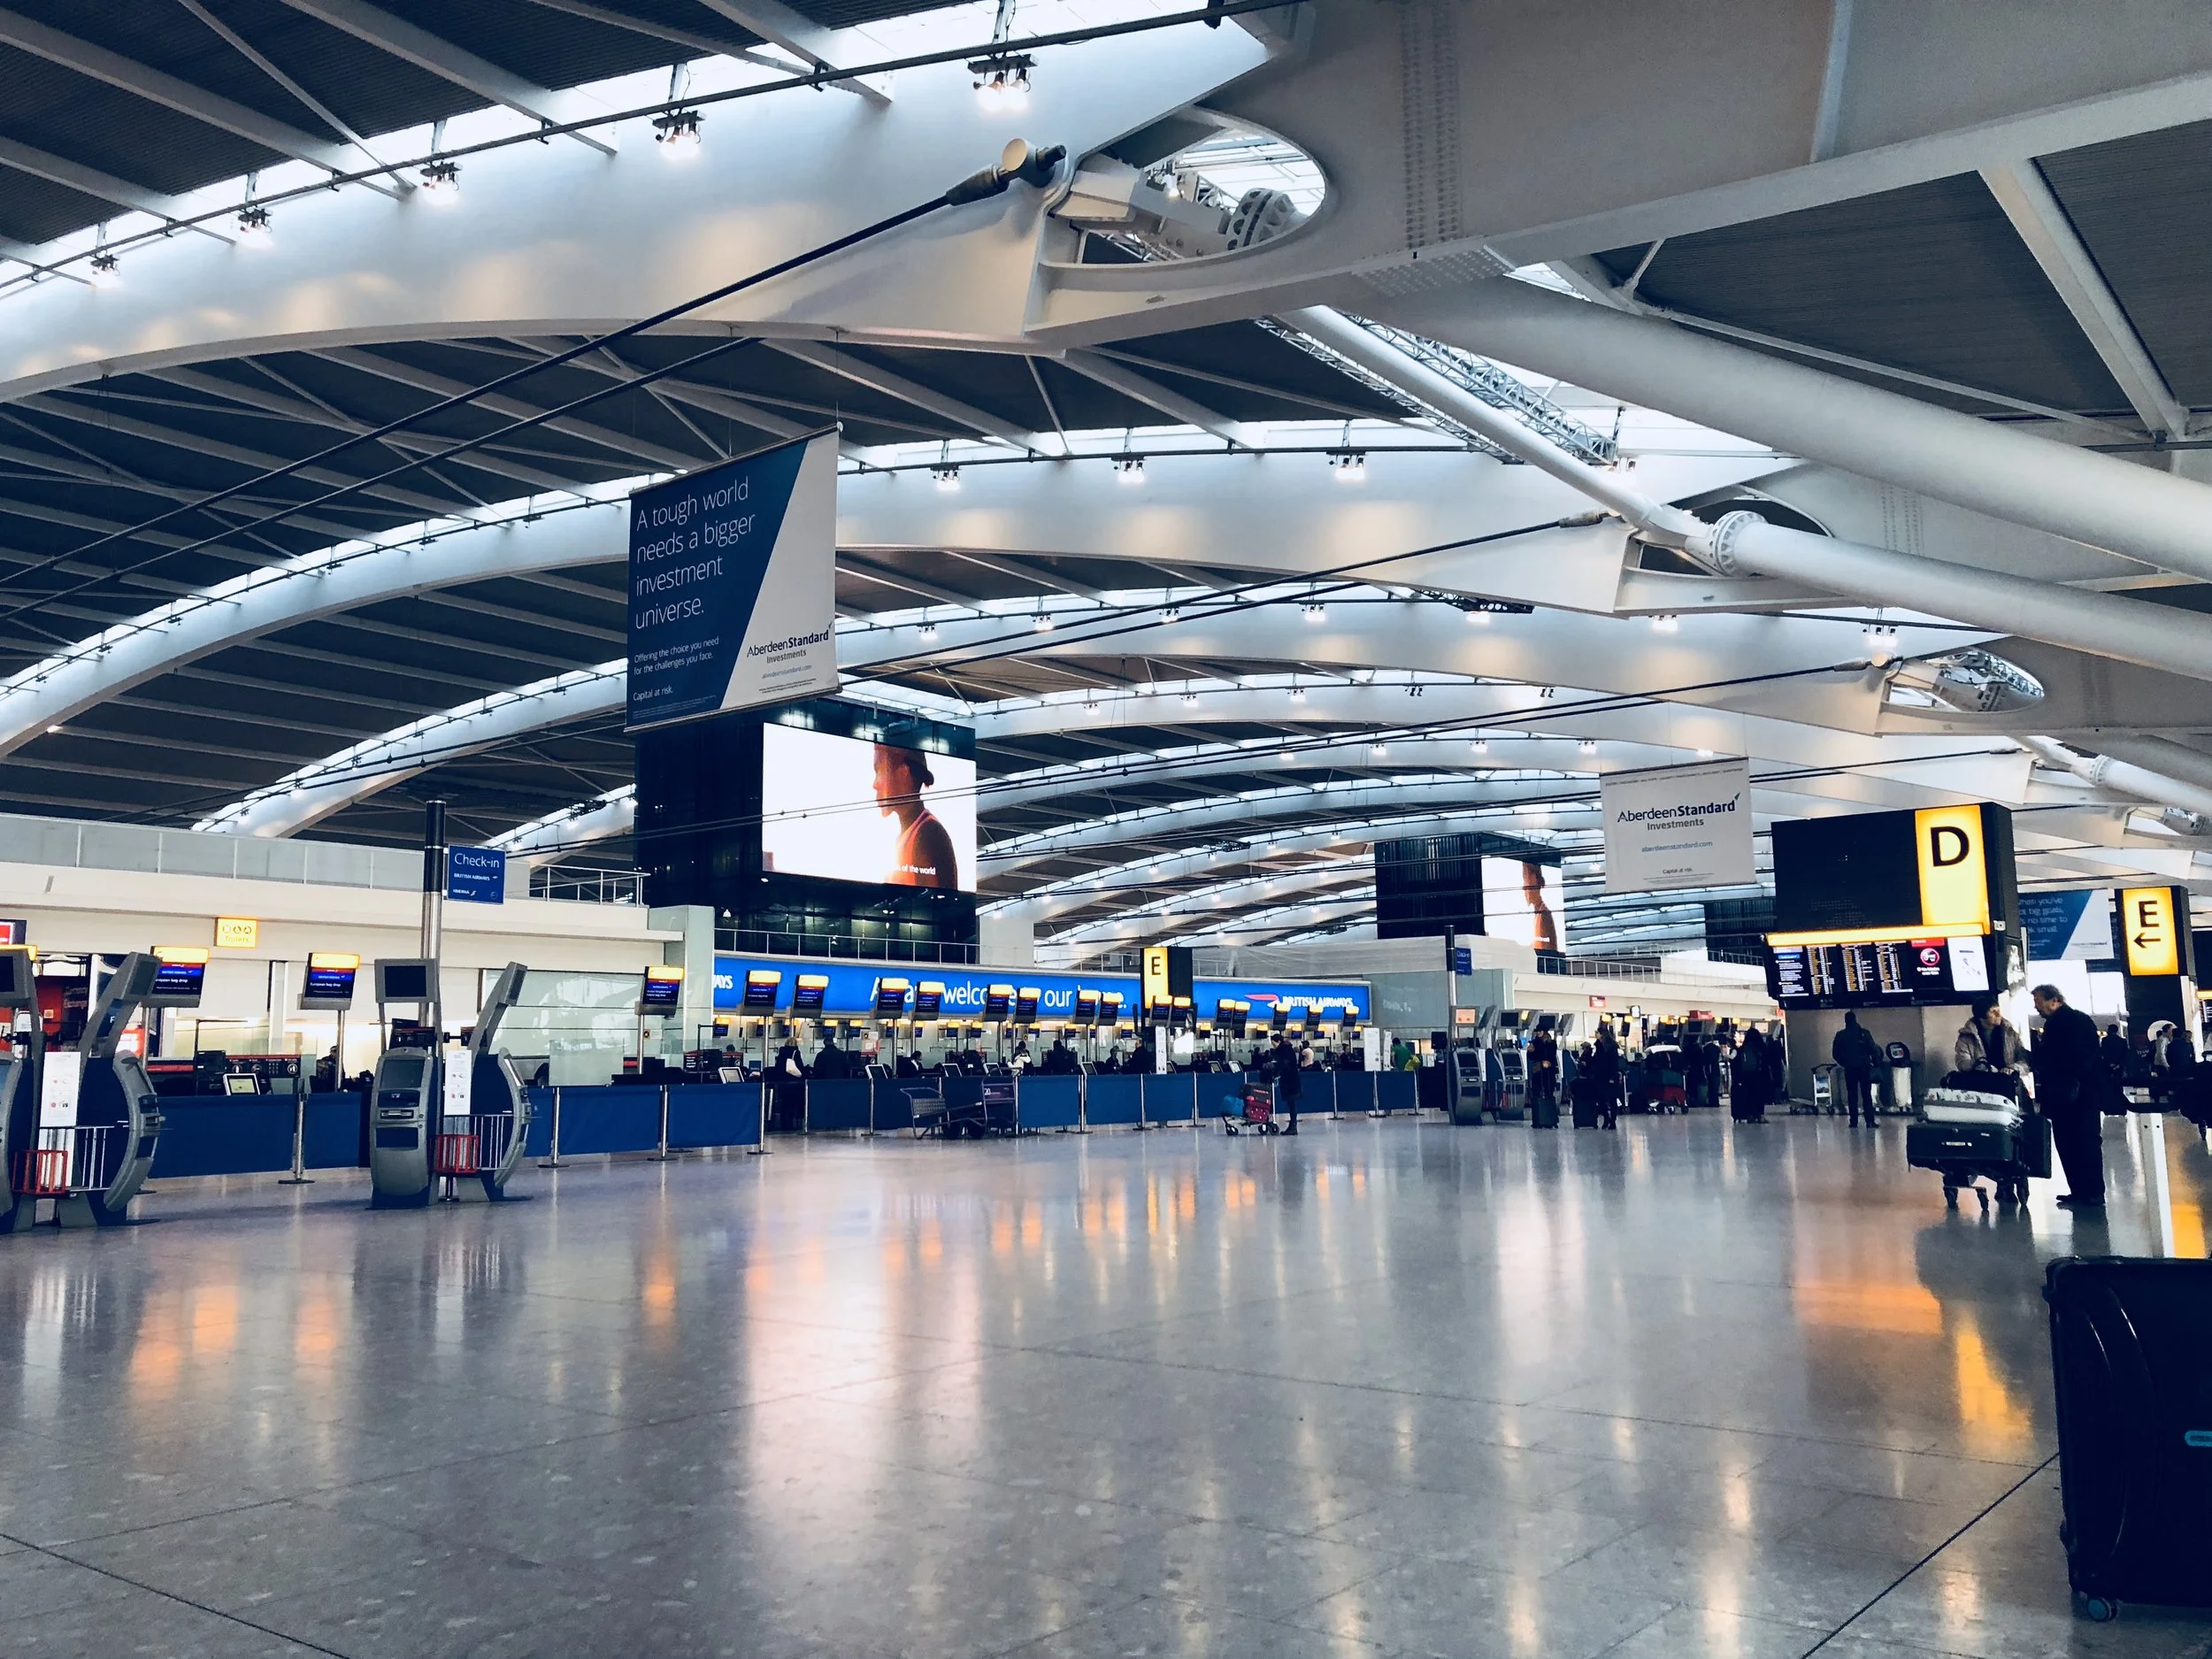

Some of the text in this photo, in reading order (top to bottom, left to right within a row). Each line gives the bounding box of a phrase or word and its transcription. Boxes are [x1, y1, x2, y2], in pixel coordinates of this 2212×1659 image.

[637, 476, 749, 531] A tough world
[637, 513, 756, 564] needs a bigger
[636, 556, 723, 596] investment
[635, 597, 704, 629] universe.
[634, 635, 719, 664] Offering the choice you need
[747, 629, 829, 657] AberdeenStandard
[643, 664, 653, 673] the
[655, 657, 685, 671] challenges
[686, 656, 697, 666] you
[699, 651, 714, 661] face.
[766, 649, 806, 664] Investments
[633, 689, 653, 702] Capital
[661, 685, 673, 694] risk.
[1617, 800, 1735, 823] AberdeenStandard
[1647, 818, 1704, 831] Investments
[1642, 841, 1713, 853] aberdeenstandard.com
[1931, 826, 1970, 867] D
[454, 853, 499, 868] Check-in
[910, 864, 918, 873] the
[919, 866, 936, 875] world
[2139, 900, 2159, 928] E
[1151, 956, 1161, 976] E
[1044, 989, 1073, 1008] our
